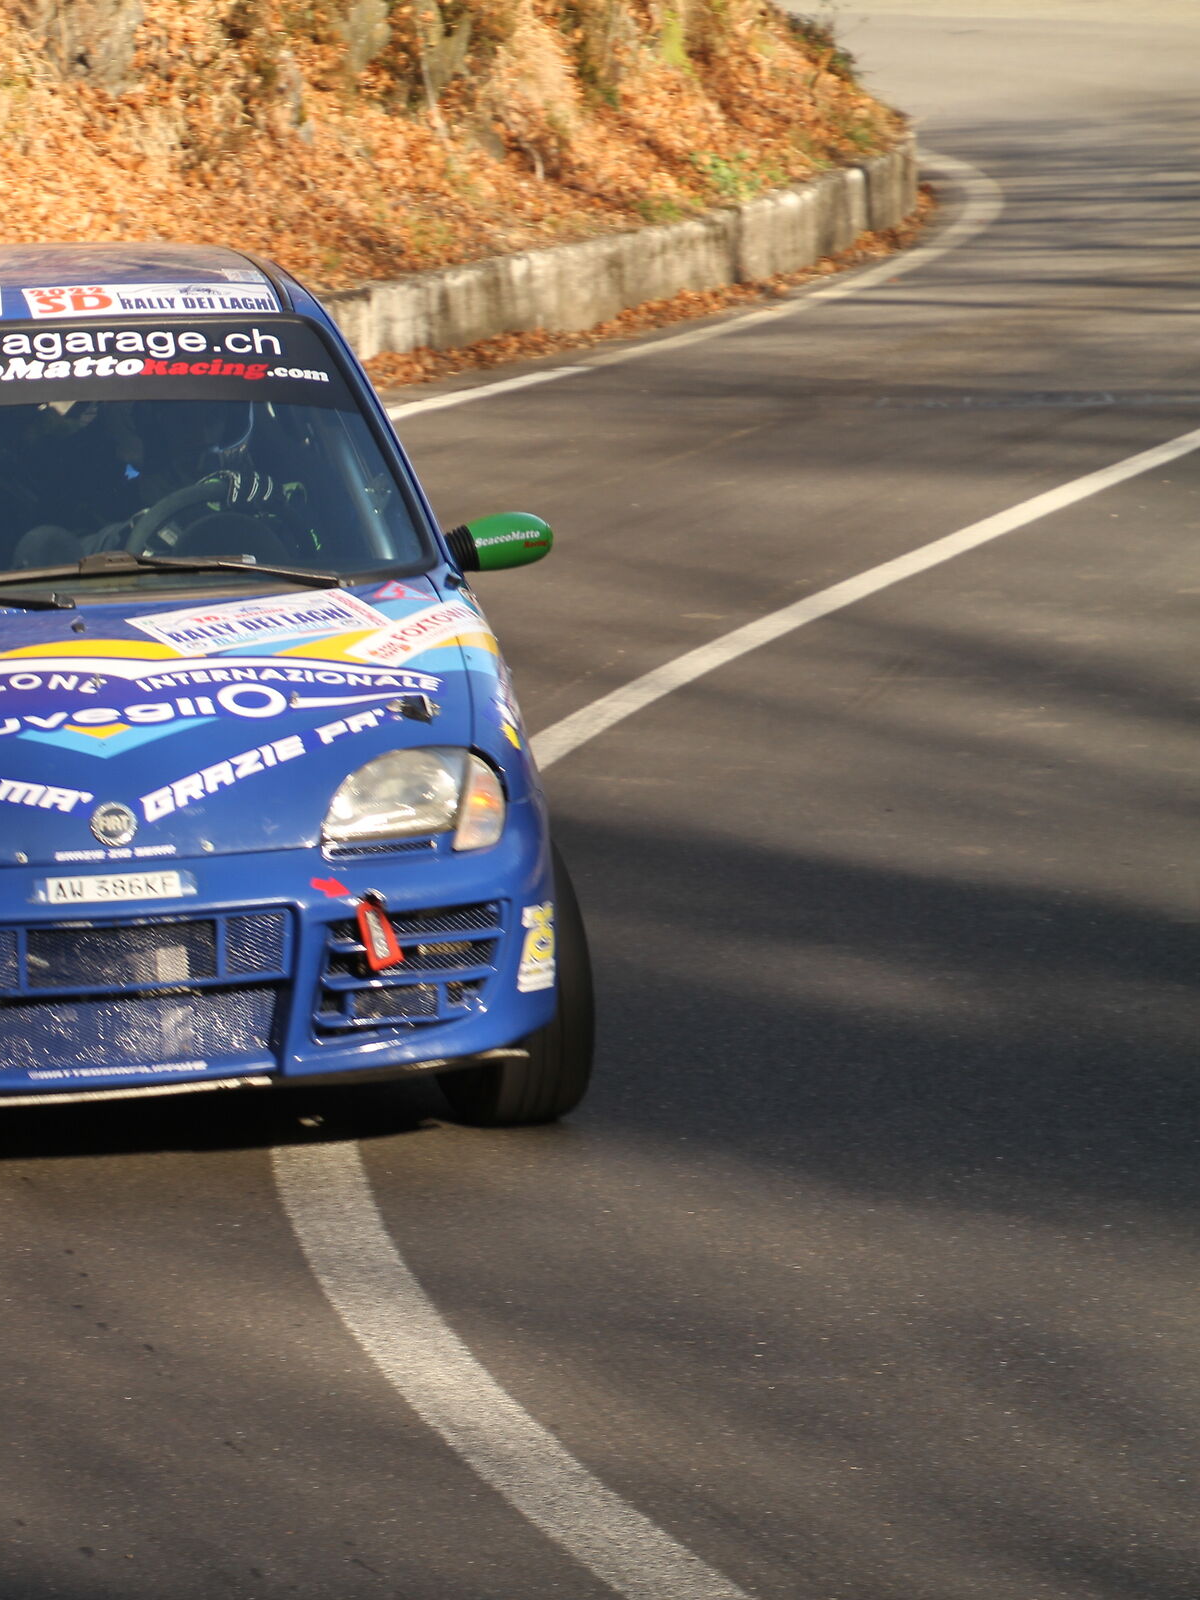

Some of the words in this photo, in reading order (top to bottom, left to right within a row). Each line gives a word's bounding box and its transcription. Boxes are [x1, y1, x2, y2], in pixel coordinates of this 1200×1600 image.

[29, 286, 105, 298] 2022
[35, 295, 113, 314] SD
[119, 297, 178, 311] RALLY
[184, 296, 216, 310] DEI
[222, 295, 278, 311] LAGHI
[474, 530, 541, 549] ScaccoMatto
[165, 619, 241, 643] RALLY
[241, 613, 288, 634] DEI
[285, 602, 354, 627] LAGHI
[391, 605, 480, 642] FOXTOWN
[135, 667, 442, 693] INTERNAZIONALE
[139, 734, 306, 823] GRAZIE
[55, 881, 84, 901] AW
